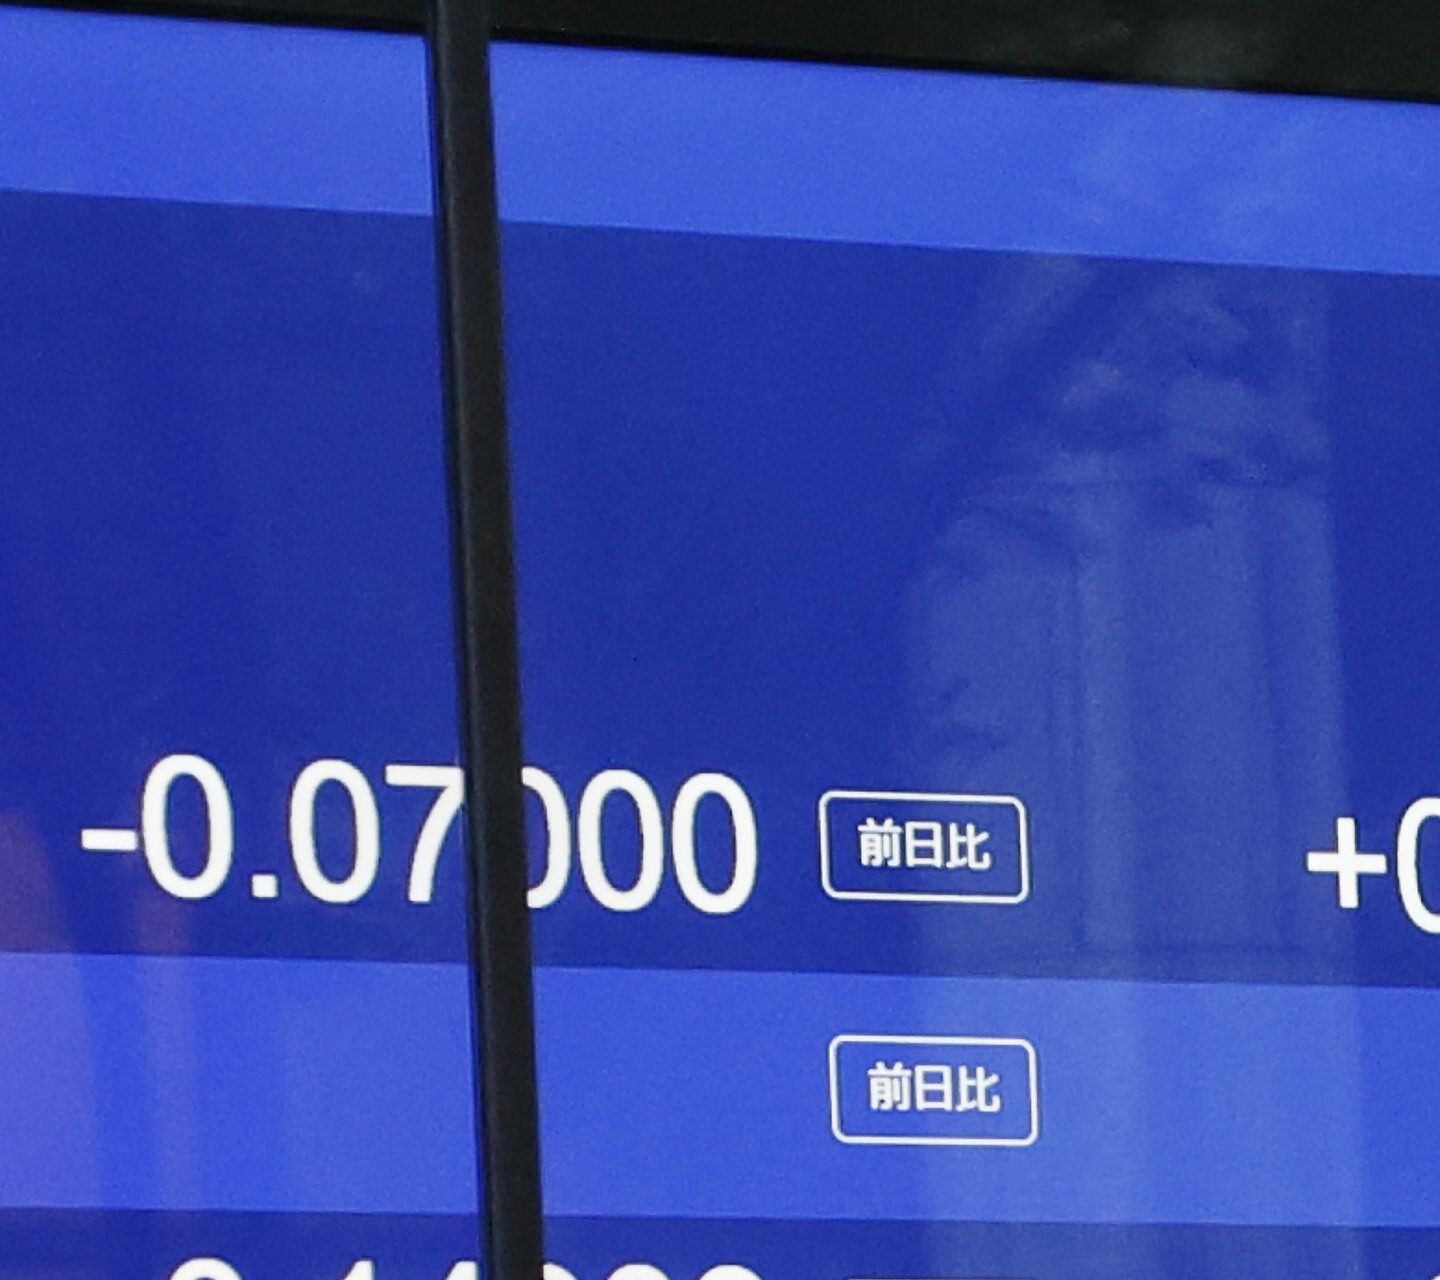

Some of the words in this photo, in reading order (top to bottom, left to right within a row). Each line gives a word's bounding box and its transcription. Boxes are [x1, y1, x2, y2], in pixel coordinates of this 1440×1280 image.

[80, 753, 758, 915] -0.07000
[856, 816, 992, 871] 前日比
[867, 1060, 1002, 1113] 前日比
